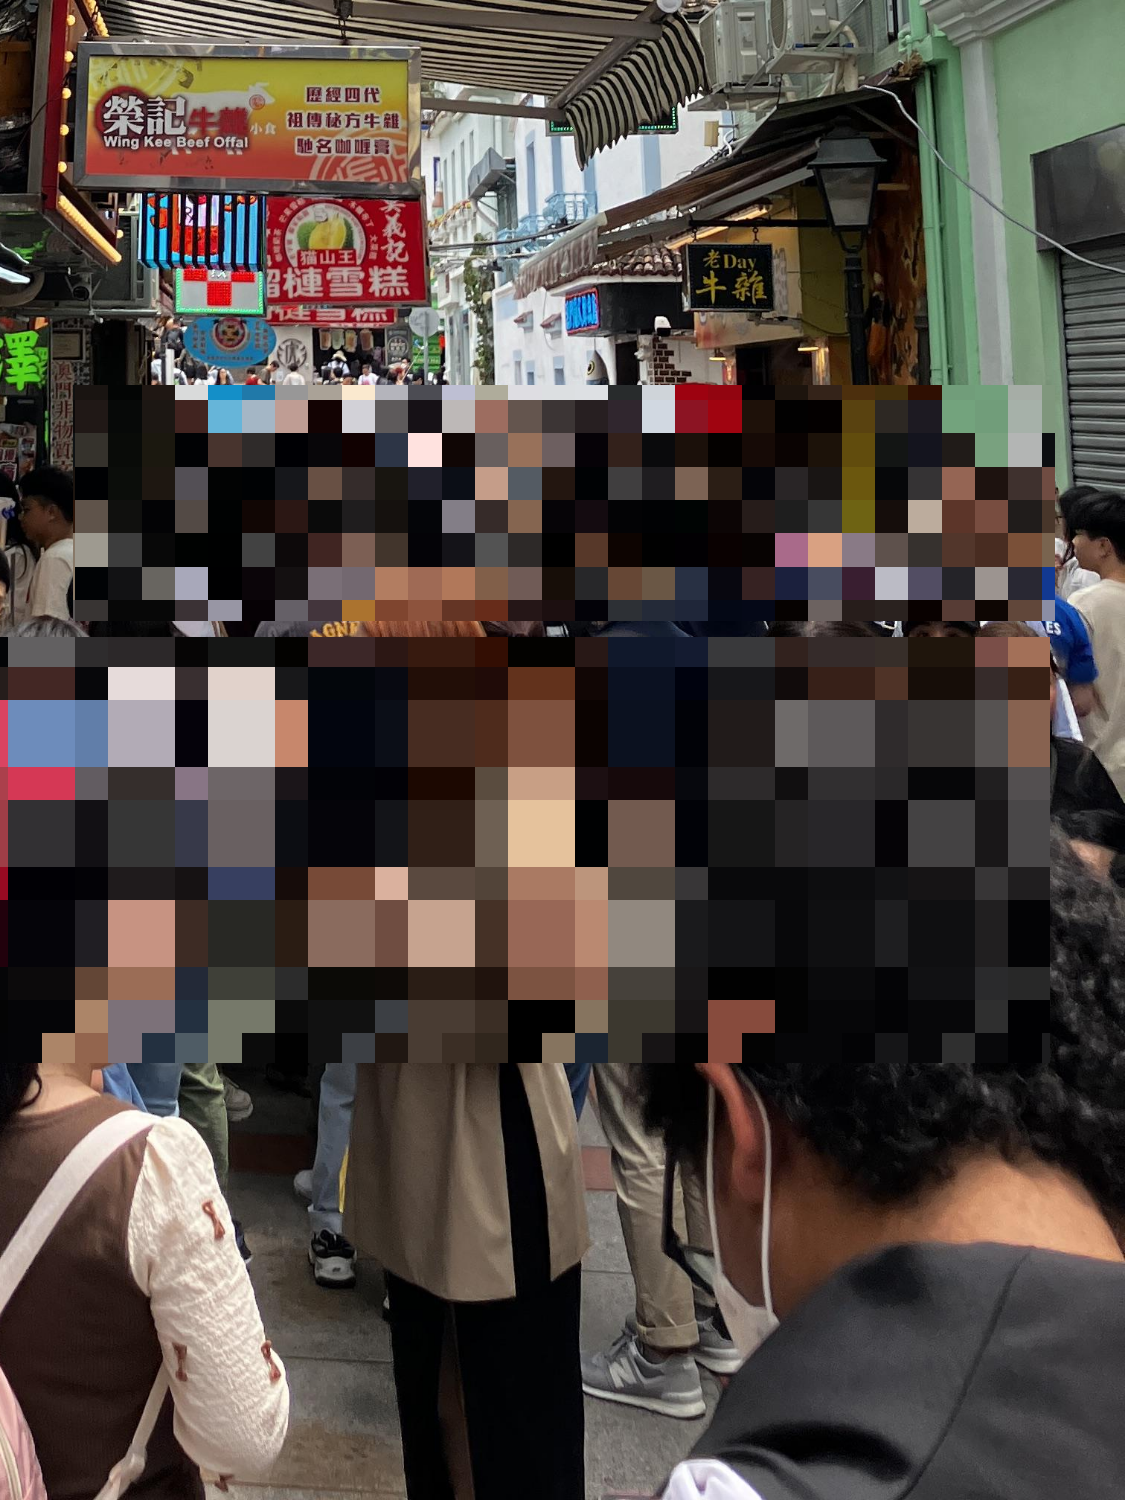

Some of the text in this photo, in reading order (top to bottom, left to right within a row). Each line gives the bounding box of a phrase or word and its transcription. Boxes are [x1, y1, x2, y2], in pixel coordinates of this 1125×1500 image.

[104, 94, 188, 136] 榮記
[250, 122, 277, 136] 小食
[286, 110, 401, 130] 祖傳秘方牛雜
[104, 135, 249, 150] Wing Kee Beef Offal
[300, 249, 356, 266] 猫山王
[696, 271, 768, 305] 牛雜
